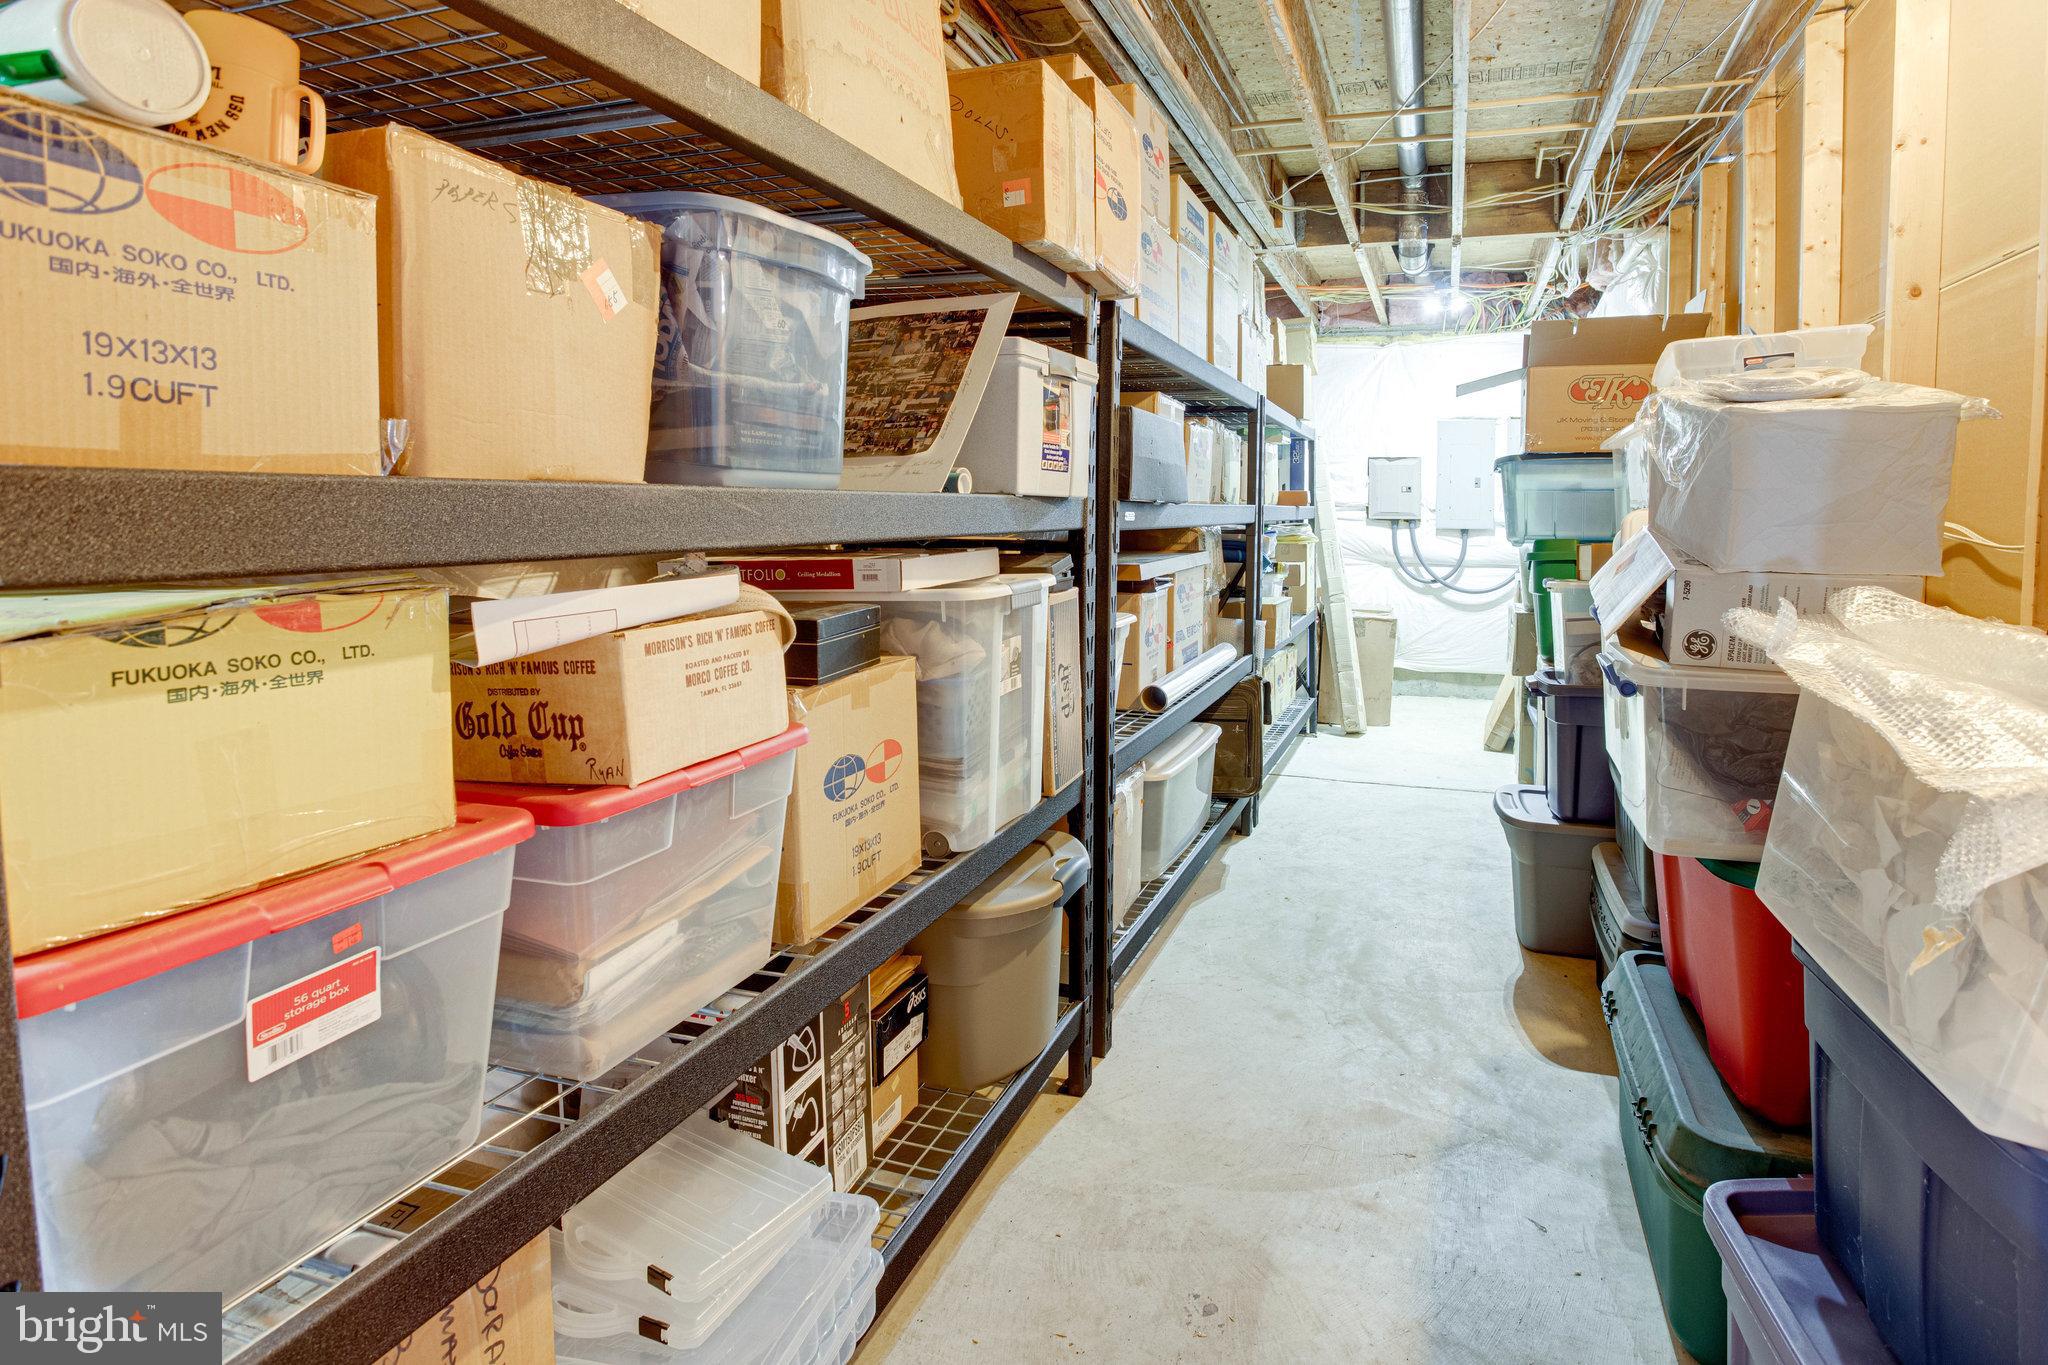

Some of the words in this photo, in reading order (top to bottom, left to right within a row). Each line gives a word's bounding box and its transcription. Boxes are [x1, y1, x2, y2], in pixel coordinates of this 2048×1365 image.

[0, 220, 109, 256] UKUOKA
[122, 244, 187, 271] SOKO
[196, 260, 237, 283] CO.,
[256, 271, 295, 292] LTD.
[83, 330, 217, 371] 19X13X13
[797, 570, 815, 578] Ceiling
[1683, 580, 1692, 600] 7-5290
[644, 635, 693, 657] MORRISON'S
[696, 631, 713, 647] RICH
[726, 623, 752, 640] FAMOUS
[755, 619, 776, 634] COFFEE
[111, 661, 217, 687] FUKUOKA
[227, 654, 281, 673] SOKO
[291, 650, 325, 665] CO.,
[342, 644, 375, 660] LTD.
[486, 662, 504, 675] RICH
[521, 661, 559, 675] FAMOUS
[564, 660, 596, 675] COFFEE
[685, 659, 710, 670] ROASTED
[711, 656, 723, 664] AND
[724, 651, 742, 661] PACKED
[685, 669, 711, 688] MORCO
[714, 663, 738, 680] COFFEE
[741, 660, 752, 673] CO.
[487, 688, 528, 696] DISTRIBUTED
[529, 688, 541, 696] BY
[455, 701, 517, 740] Gold
[528, 701, 585, 752] Cup
[832, 802, 858, 822] FUKUOKA
[860, 795, 875, 808] SOKO
[284, 995, 326, 1021] storage
[329, 984, 350, 999] box
[294, 993, 308, 1006] 56
[311, 979, 341, 999] quart
